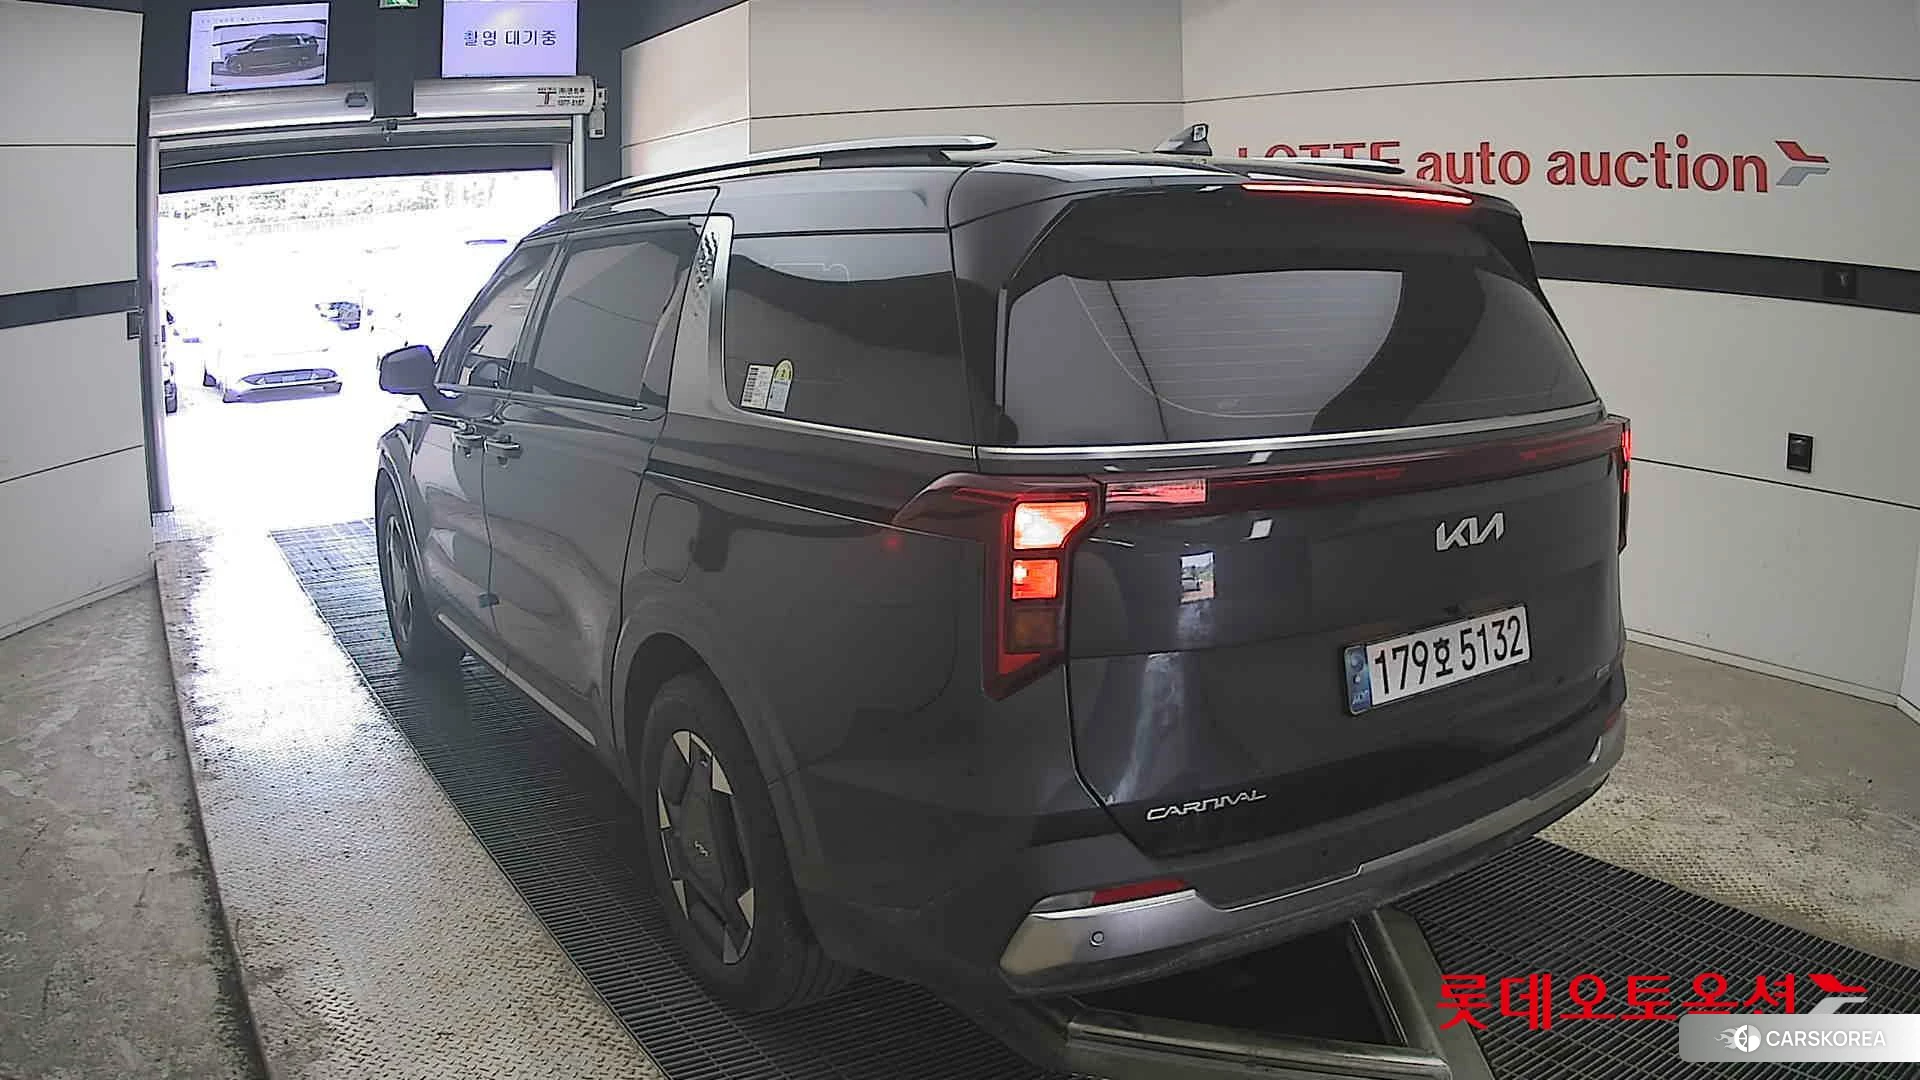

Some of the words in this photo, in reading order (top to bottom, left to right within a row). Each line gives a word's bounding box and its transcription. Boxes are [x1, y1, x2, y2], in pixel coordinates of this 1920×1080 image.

[505, 30, 557, 47] 대기중
[1416, 141, 1531, 185] auto
[1546, 133, 1769, 193] auction
[1436, 512, 1504, 551] KIA
[1146, 789, 1268, 821] CARNIVAL
